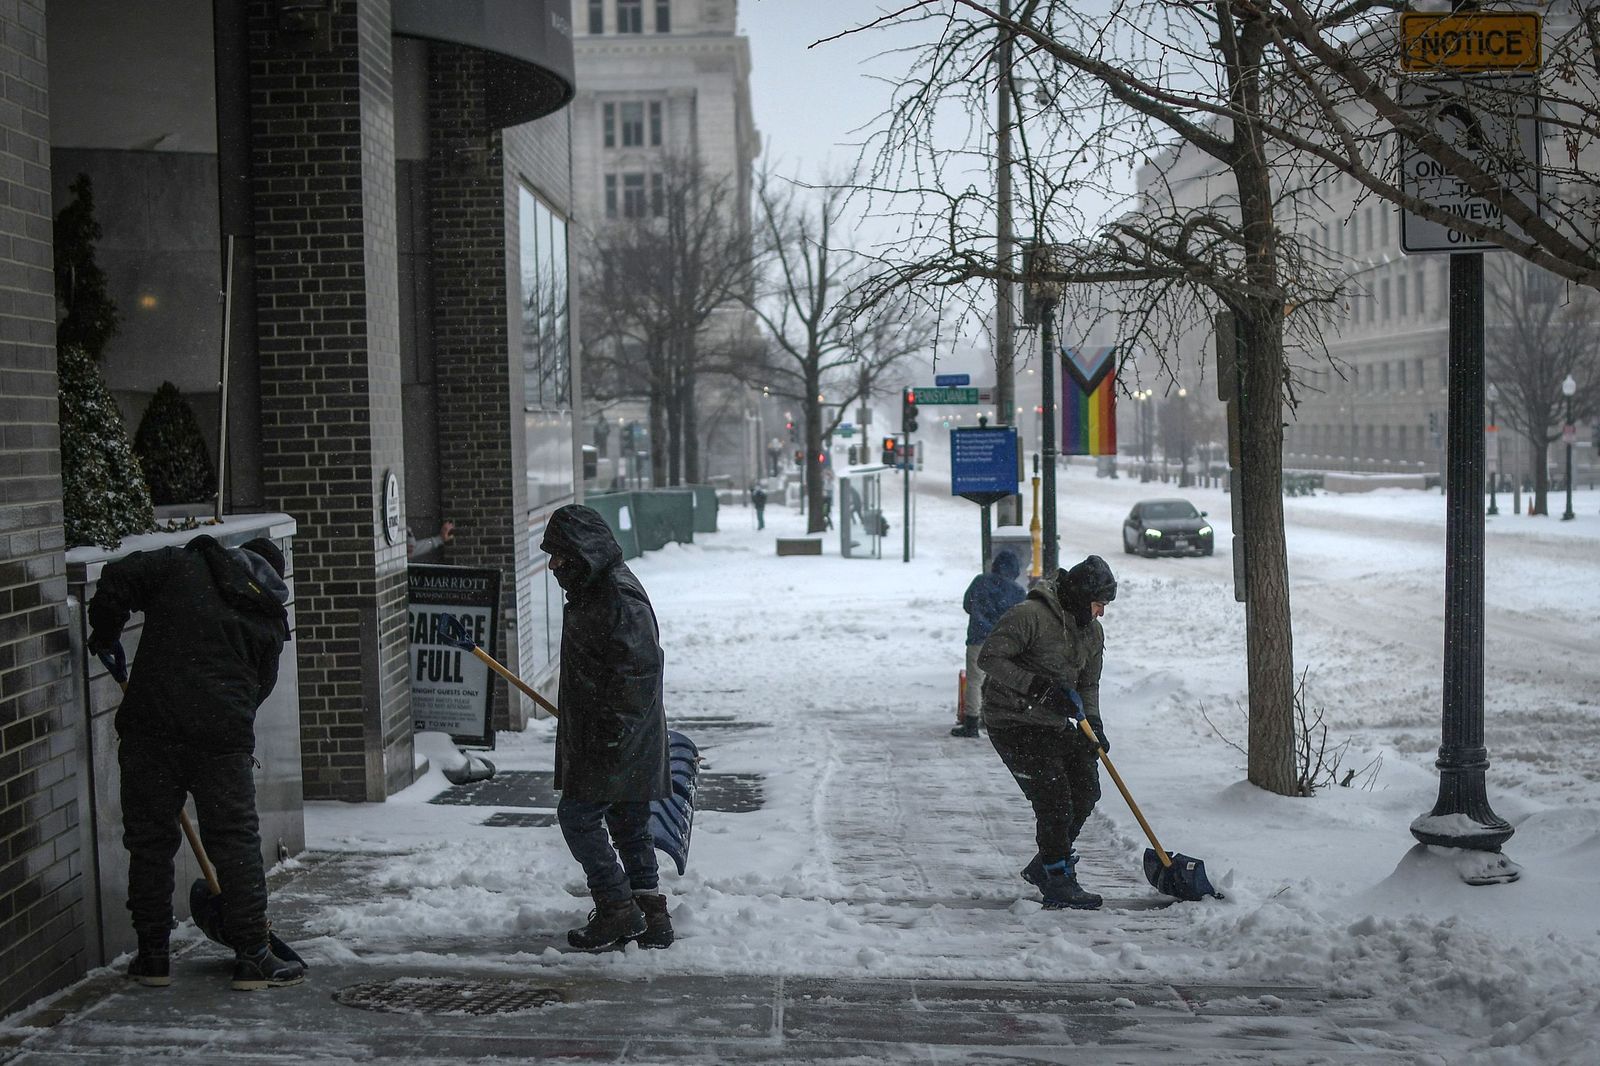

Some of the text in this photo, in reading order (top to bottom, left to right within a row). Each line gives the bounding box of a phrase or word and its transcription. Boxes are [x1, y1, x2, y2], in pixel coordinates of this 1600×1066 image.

[1421, 30, 1522, 56] NOTICE
[424, 575, 489, 589] MARRIOTT
[417, 649, 463, 683] FULL
[437, 688, 460, 696] GUESTS
[462, 689, 480, 697] ONLY
[428, 720, 460, 728] TOWNE
